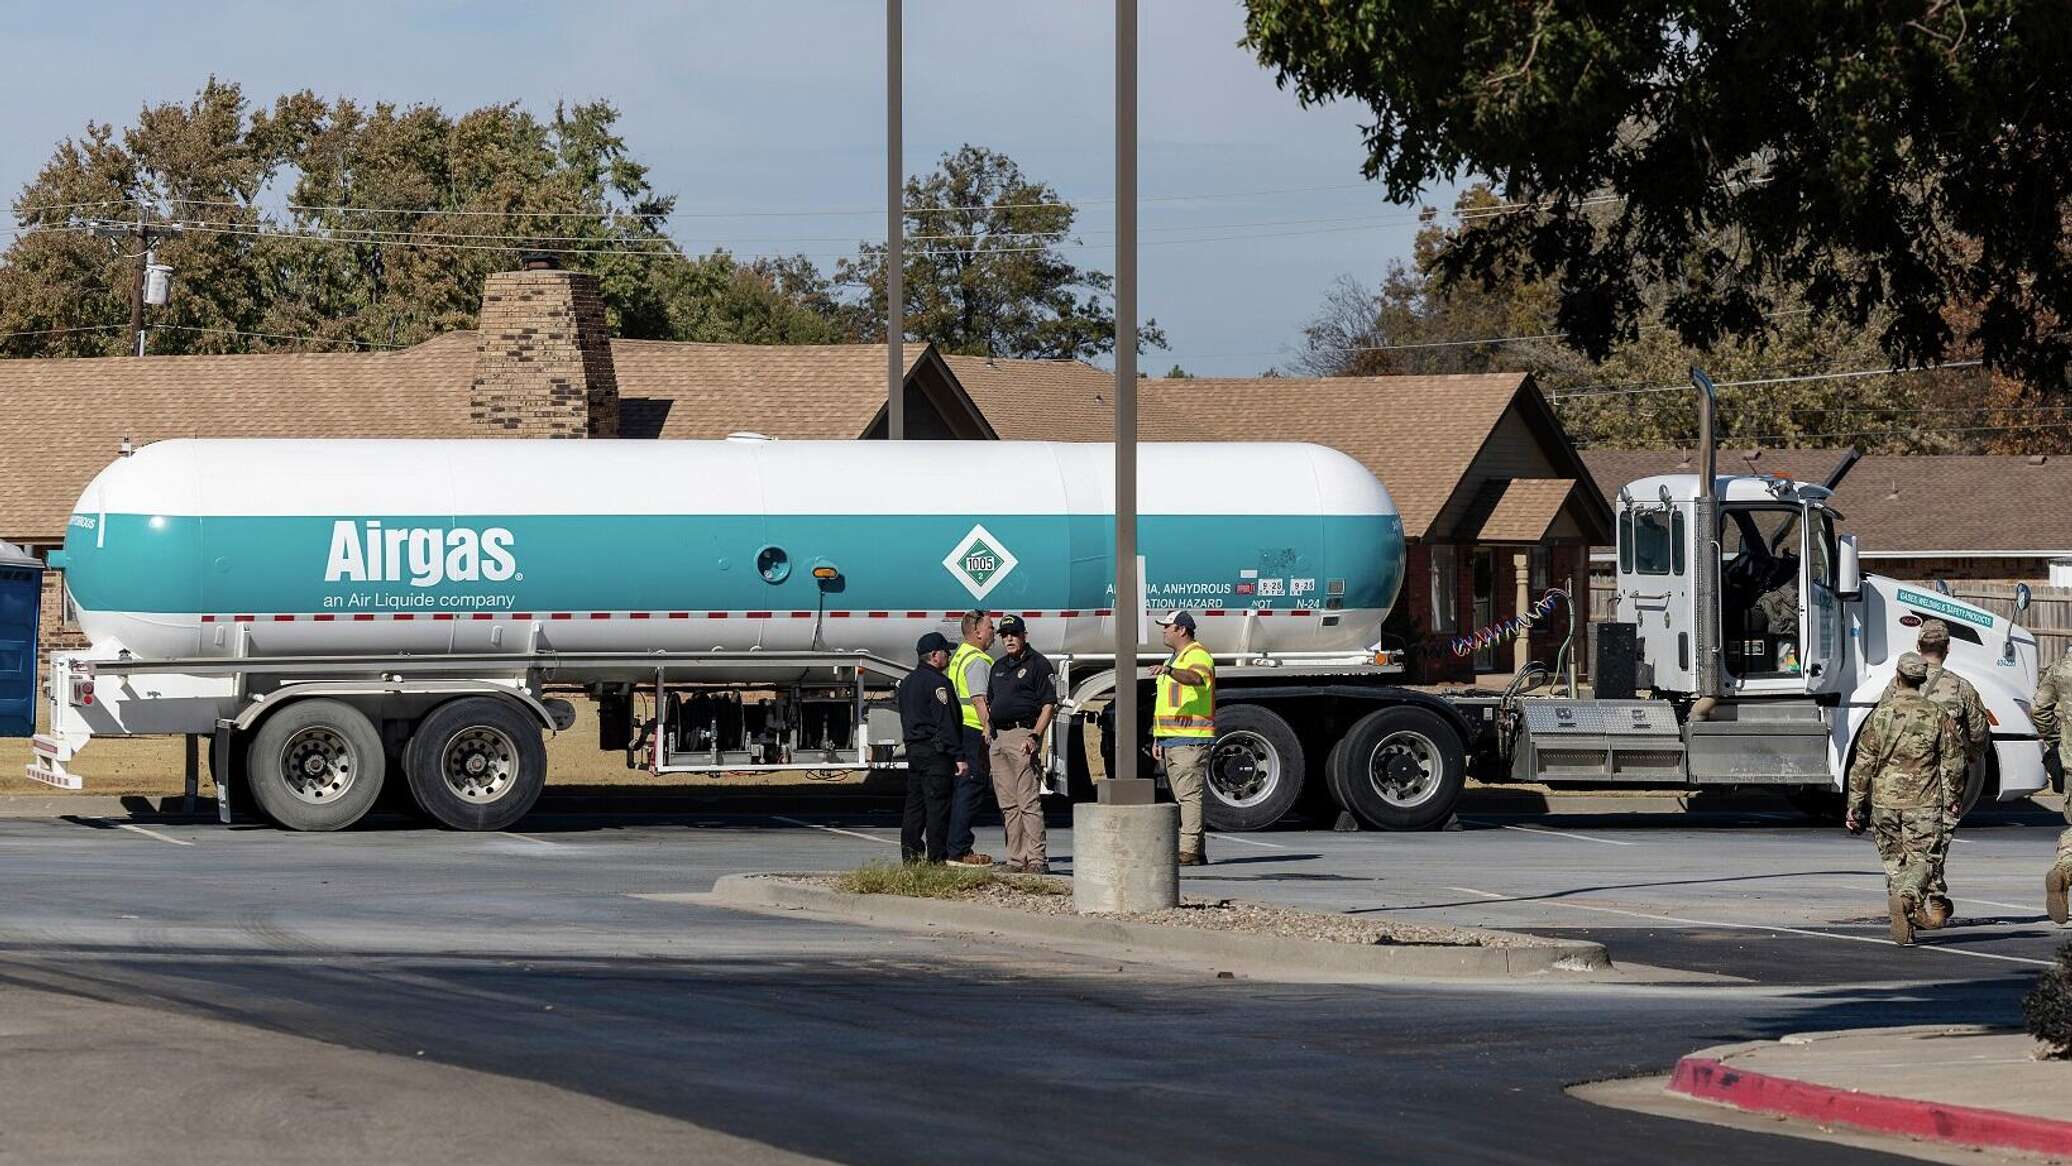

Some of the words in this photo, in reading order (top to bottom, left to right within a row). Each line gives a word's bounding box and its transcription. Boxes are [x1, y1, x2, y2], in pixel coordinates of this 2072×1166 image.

[324, 520, 516, 587] Airgas
[969, 558, 993, 570] 1005
[978, 572, 984, 580] 2
[1163, 583, 1231, 594] ANHYDROUS
[323, 596, 343, 608] an
[347, 592, 372, 607] Air
[375, 592, 434, 610] Liquide
[439, 595, 515, 610] company
[1178, 599, 1223, 608] HAZARD
[1296, 599, 1320, 609] N-24
